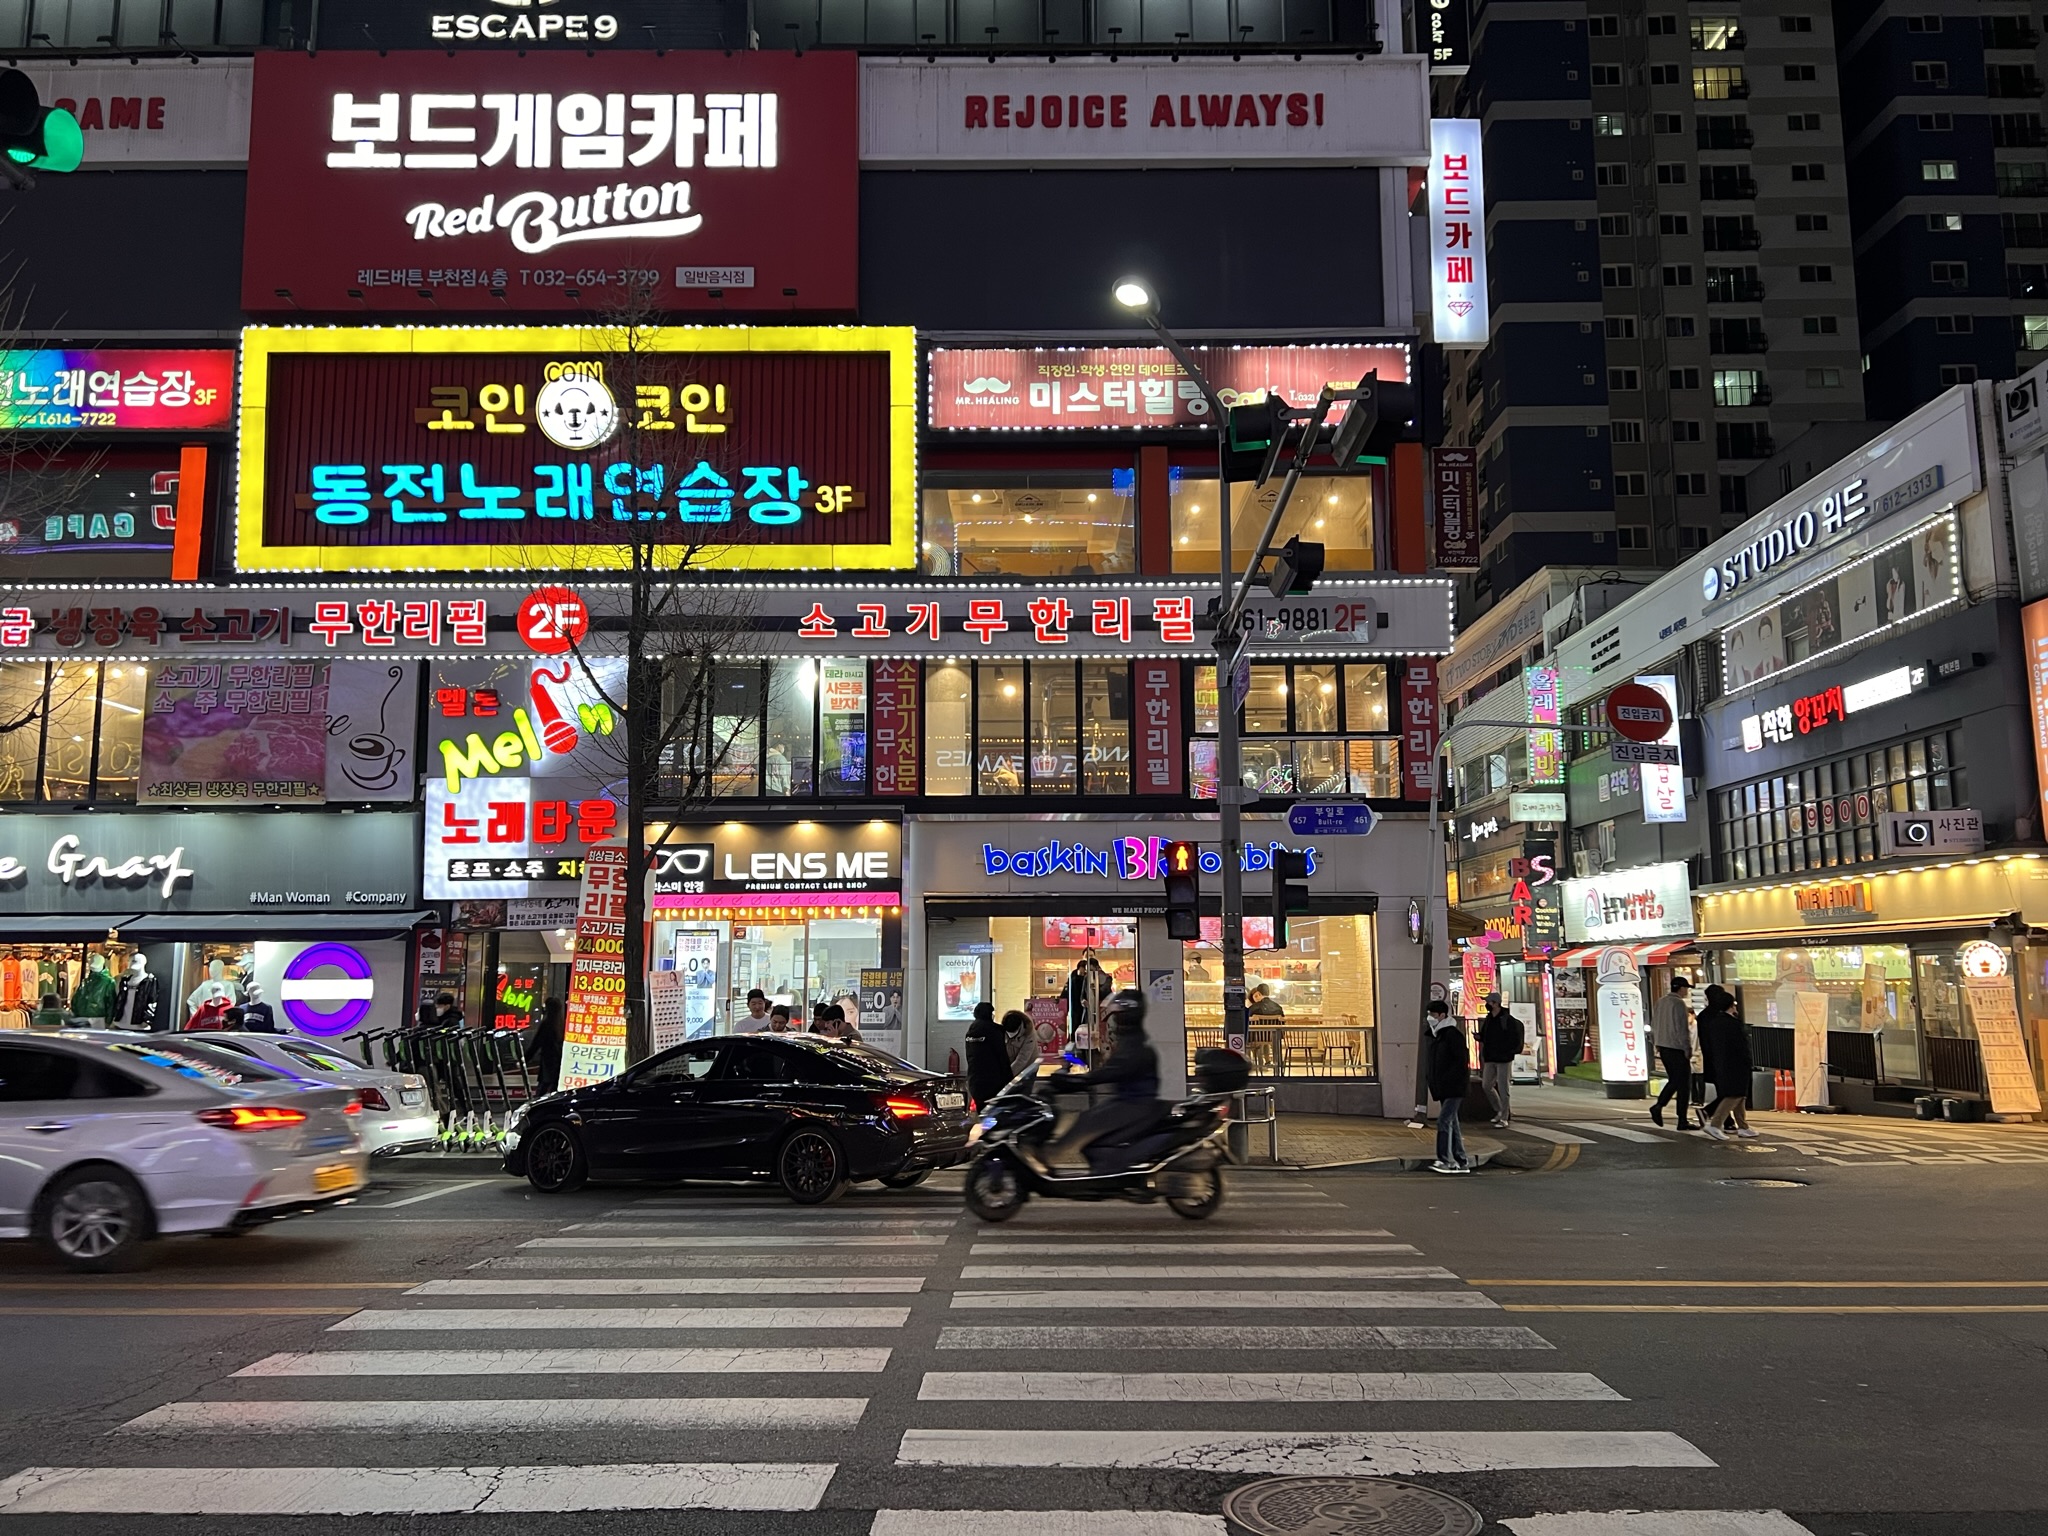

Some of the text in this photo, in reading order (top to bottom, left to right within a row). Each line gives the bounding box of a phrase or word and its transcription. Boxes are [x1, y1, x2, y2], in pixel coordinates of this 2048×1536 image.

[1433, 48, 1453, 61] 5F
[964, 92, 1326, 129] REJOICE ALWAYS!
[326, 91, 778, 170] 보드게임카페
[406, 180, 703, 254] Red Button
[1441, 153, 1475, 286] 보드카페
[357, 268, 424, 287] 레드버튼
[533, 268, 660, 287] 032-654-3799
[683, 270, 746, 284] 일반음식점
[543, 361, 604, 384] COIN
[194, 388, 218, 406] 3F
[976, 396, 1020, 406] HEALING
[1029, 378, 1209, 416] 미스터힐링
[426, 383, 727, 434] 코인 코인
[310, 461, 853, 526] 동전노래연습장 3F
[1441, 470, 1461, 540] 미스터힐링
[1722, 510, 1815, 592] STUDIO
[1821, 477, 1871, 534] 위드
[49, 606, 167, 648] 냉장육
[179, 605, 292, 647] 소고기
[309, 598, 488, 648] 무한리필
[527, 602, 583, 641] 2F
[797, 596, 1197, 646] 소고기 무한리필
[1334, 603, 1367, 632] 2F
[154, 663, 314, 689] 소고기 무한리필
[825, 681, 864, 695] 사은품
[223, 689, 312, 714] 무한리필
[829, 696, 859, 711] 받자!
[1620, 706, 1662, 721] 진입금지
[1145, 669, 1171, 787] 무한리필
[1406, 666, 1434, 789] 무한리필
[1614, 744, 1678, 763] 진입금지
[160, 781, 310, 797] 최상급 냉장육 무한리필
[441, 799, 619, 845] 노래타운
[1292, 816, 1307, 825] 457
[1354, 816, 1368, 825] 461
[1314, 806, 1345, 818] 부일로
[1938, 817, 1979, 832] 사진관
[47, 833, 195, 898] Gray
[588, 850, 628, 864] 최상급소
[724, 850, 889, 881] LENS ME
[982, 839, 1109, 879] baskin
[683, 880, 705, 894] 안경
[745, 883, 782, 891] PREMIUM
[783, 883, 821, 891] CONTACT
[823, 882, 844, 890] LENS
[249, 890, 407, 906] #Man Woman #Company
[580, 920, 625, 937] 소고기코
[573, 975, 626, 993] 13,800
[569, 1045, 620, 1061] 우리동네
[569, 1061, 615, 1077] 소고기
